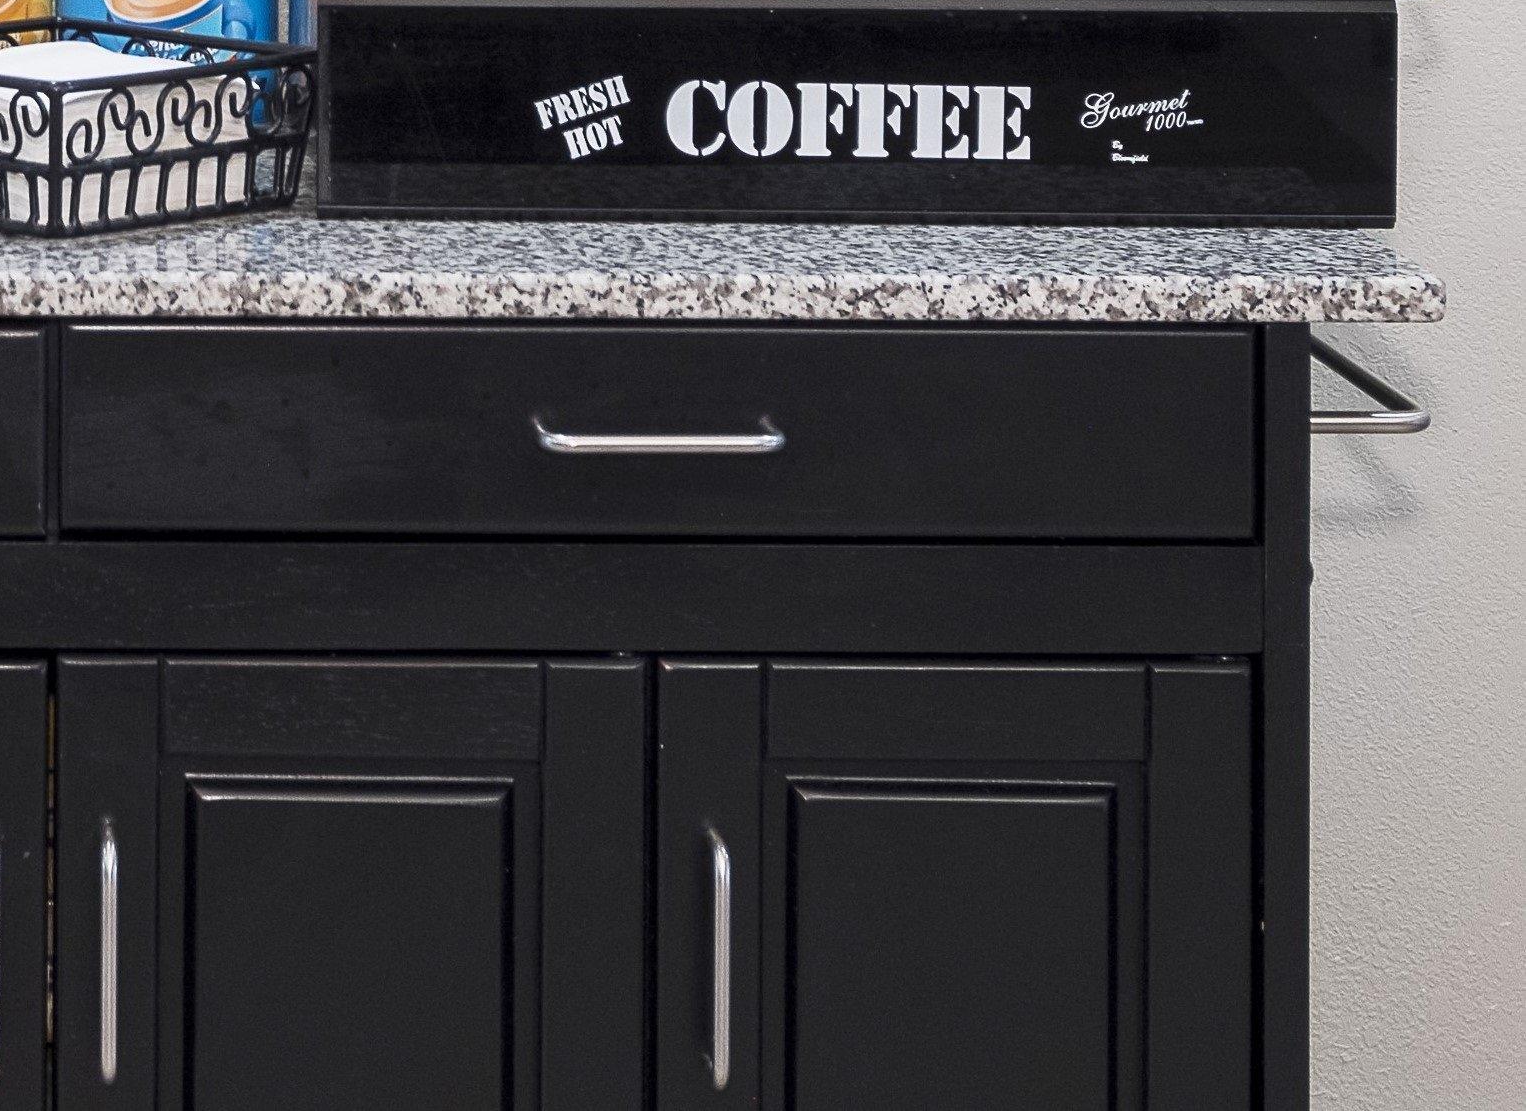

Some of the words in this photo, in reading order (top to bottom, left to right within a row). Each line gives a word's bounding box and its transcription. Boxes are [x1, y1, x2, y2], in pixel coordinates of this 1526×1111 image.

[532, 75, 631, 131] FRESH
[666, 79, 1032, 160] COFFEE
[1080, 89, 1192, 129] Gourmet
[1145, 111, 1187, 132] 1000
[563, 115, 626, 159] HOT
